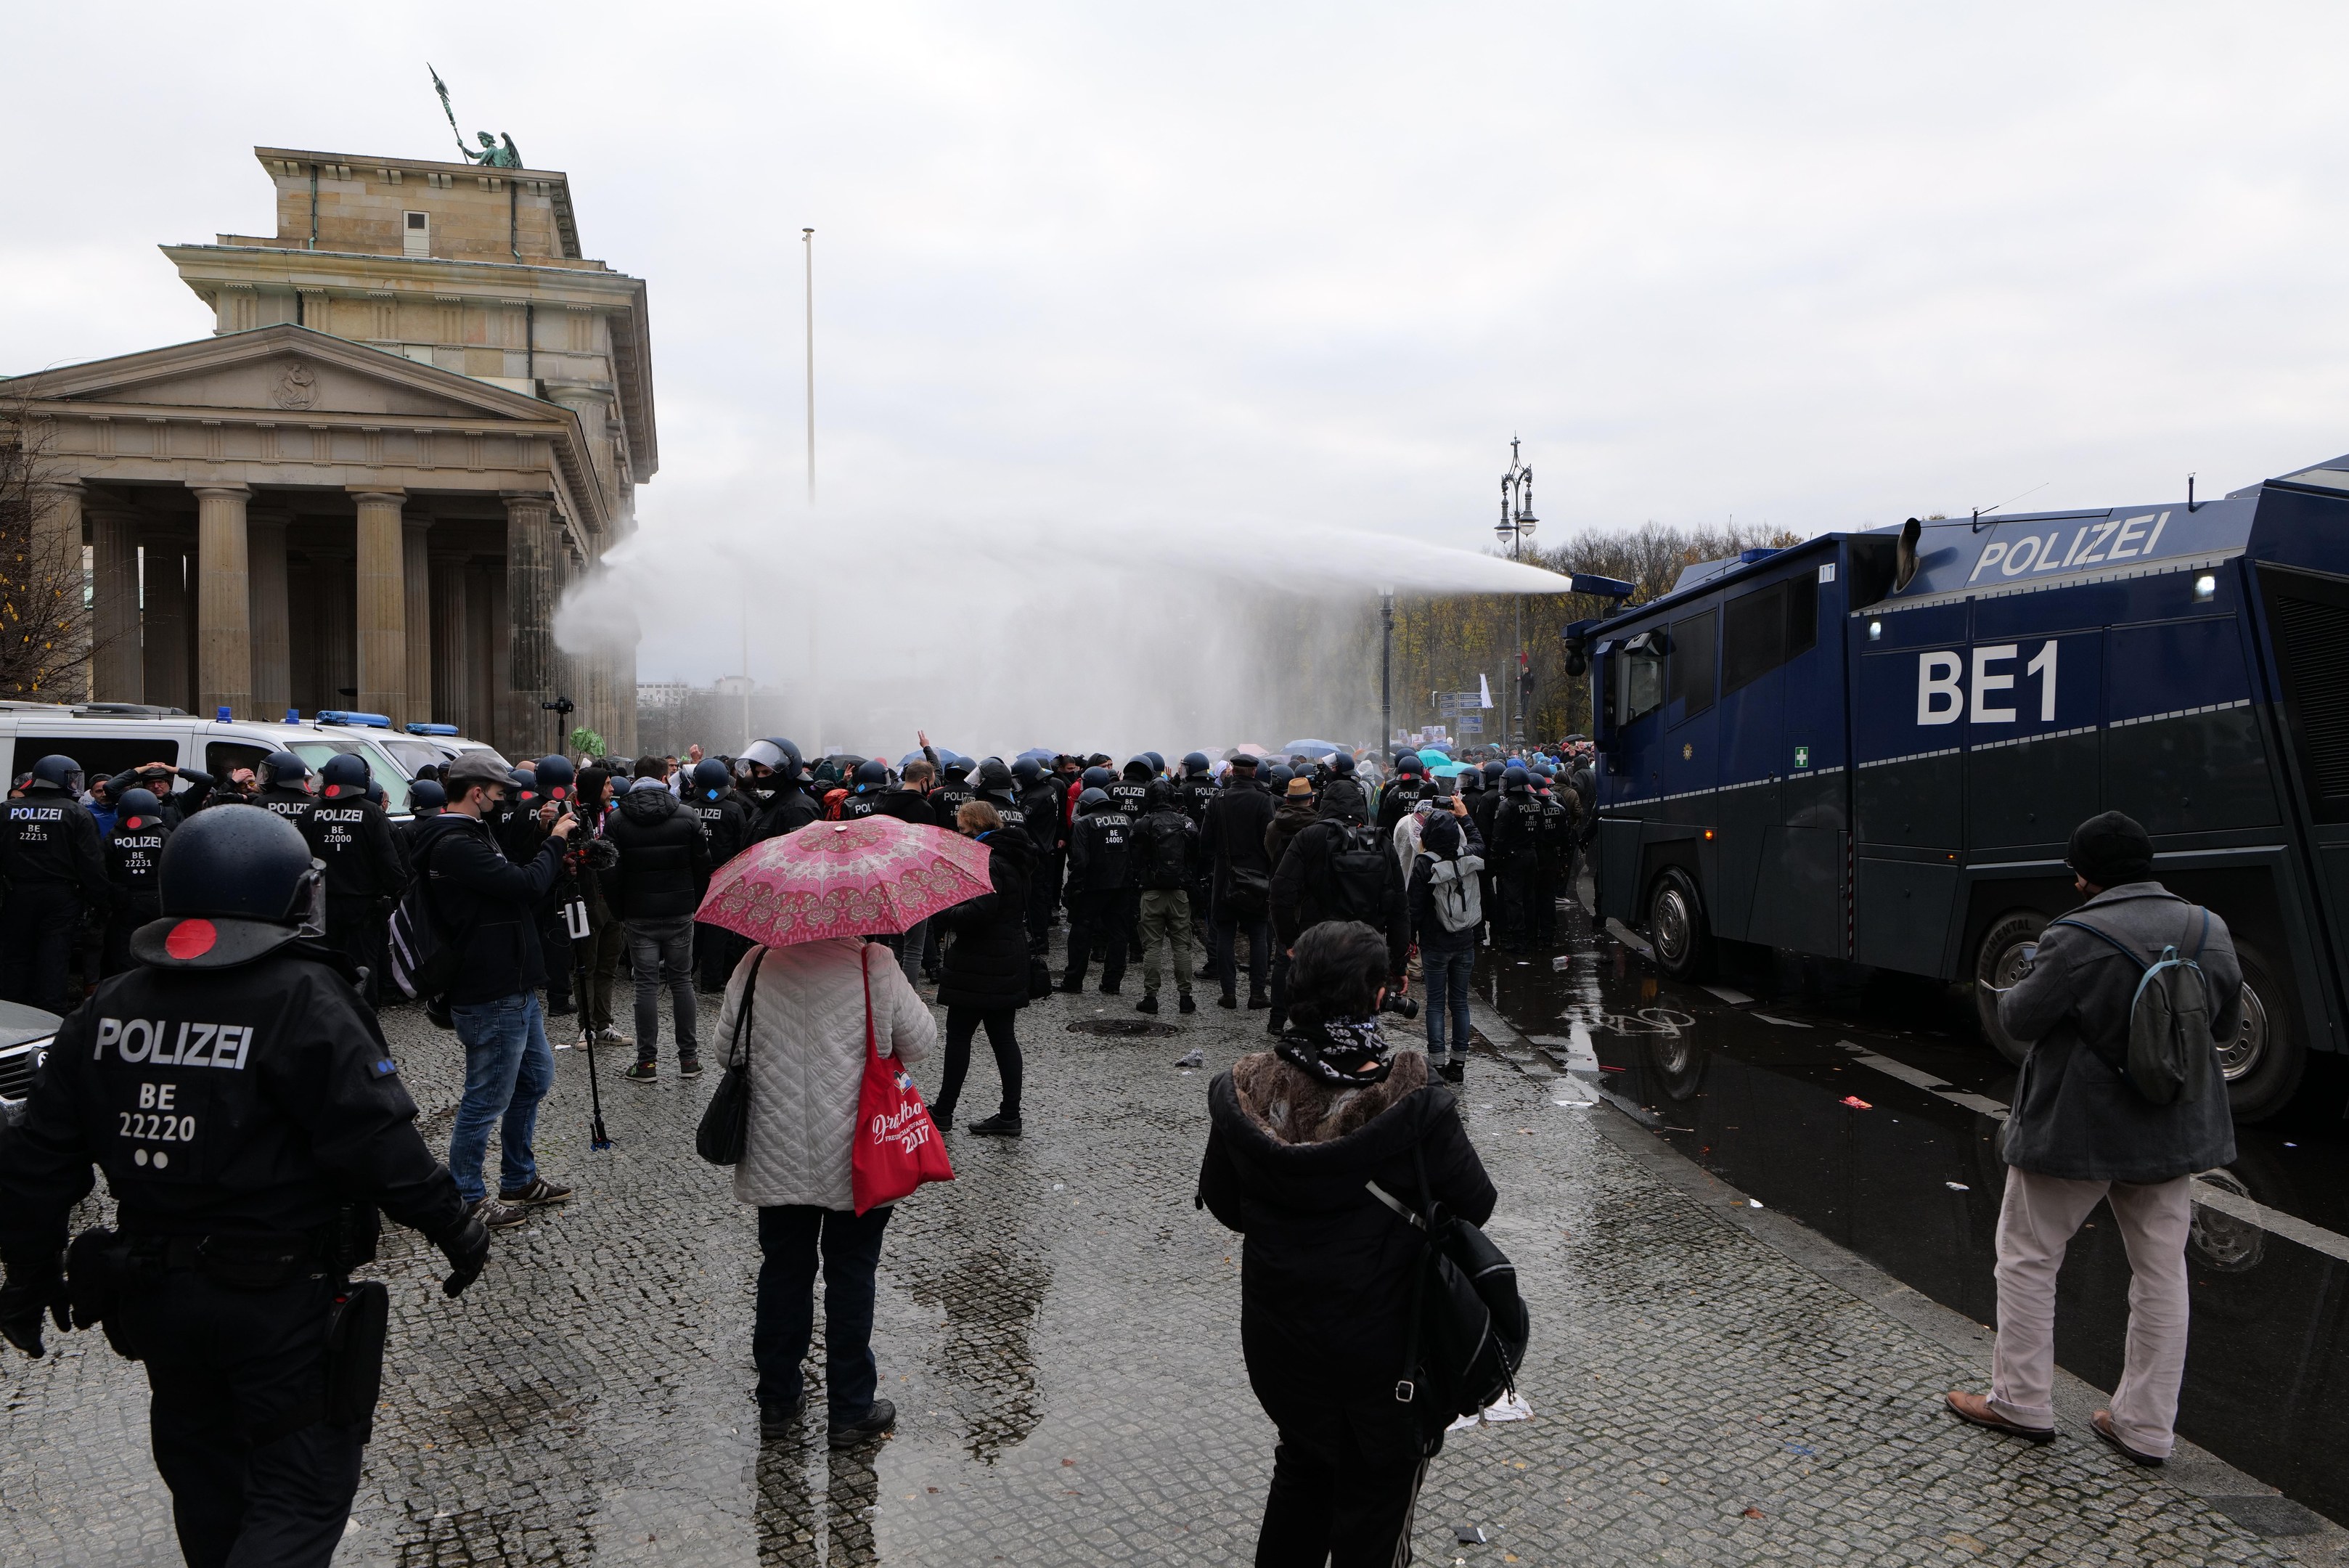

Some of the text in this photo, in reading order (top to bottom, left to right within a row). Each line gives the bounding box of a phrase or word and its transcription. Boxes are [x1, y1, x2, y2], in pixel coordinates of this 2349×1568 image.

[1969, 511, 2171, 581] POLIZEI
[1917, 640, 2058, 726] BE1
[944, 791, 968, 801] POLIZ
[1113, 786, 1145, 797] POLIZEI
[1195, 787, 1220, 796] POLIZ
[10, 807, 62, 820] POLIZEI
[268, 802, 311, 814] POLIZ
[695, 807, 722, 820] OLIZEI
[1518, 804, 1540, 813] POLIZEI
[1543, 807, 1561, 817] LIZEI
[314, 809, 364, 822] POLIZEI
[998, 809, 1024, 822] POLIZEI
[1095, 815, 1128, 827] POLIZEI
[28, 824, 41, 833] BE
[115, 836, 162, 849] POLIZEI
[93, 1018, 254, 1070] POLIZEI
[139, 1082, 176, 1110] BE
[119, 1112, 195, 1142] 22220
[902, 1124, 929, 1154] 2017
